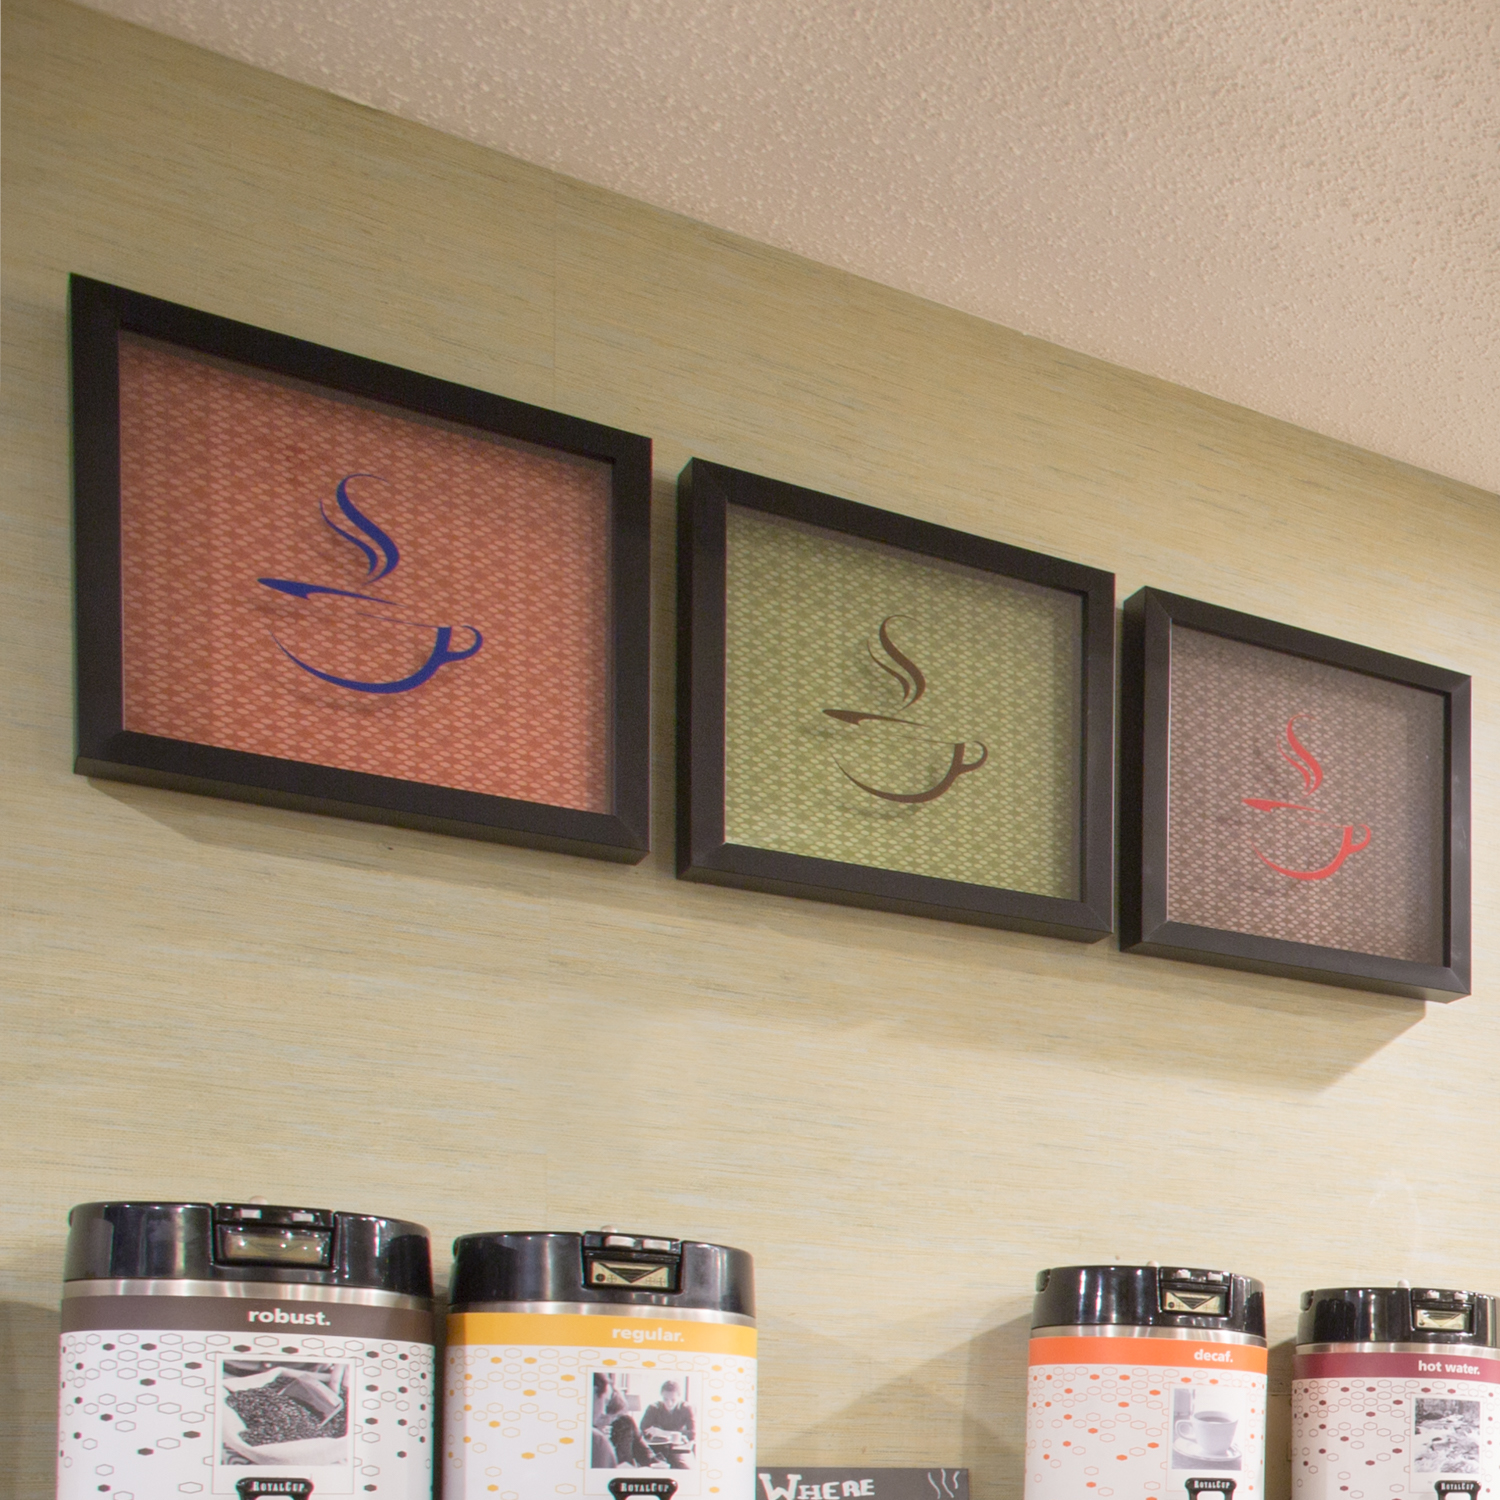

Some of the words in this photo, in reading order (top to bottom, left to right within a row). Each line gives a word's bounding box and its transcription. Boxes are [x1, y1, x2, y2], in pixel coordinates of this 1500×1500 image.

[248, 1308, 331, 1326] robust.
[612, 1327, 685, 1343] regular.
[1194, 1349, 1233, 1363] decaf.
[1418, 1360, 1442, 1372] hot
[1445, 1363, 1480, 1375] water.
